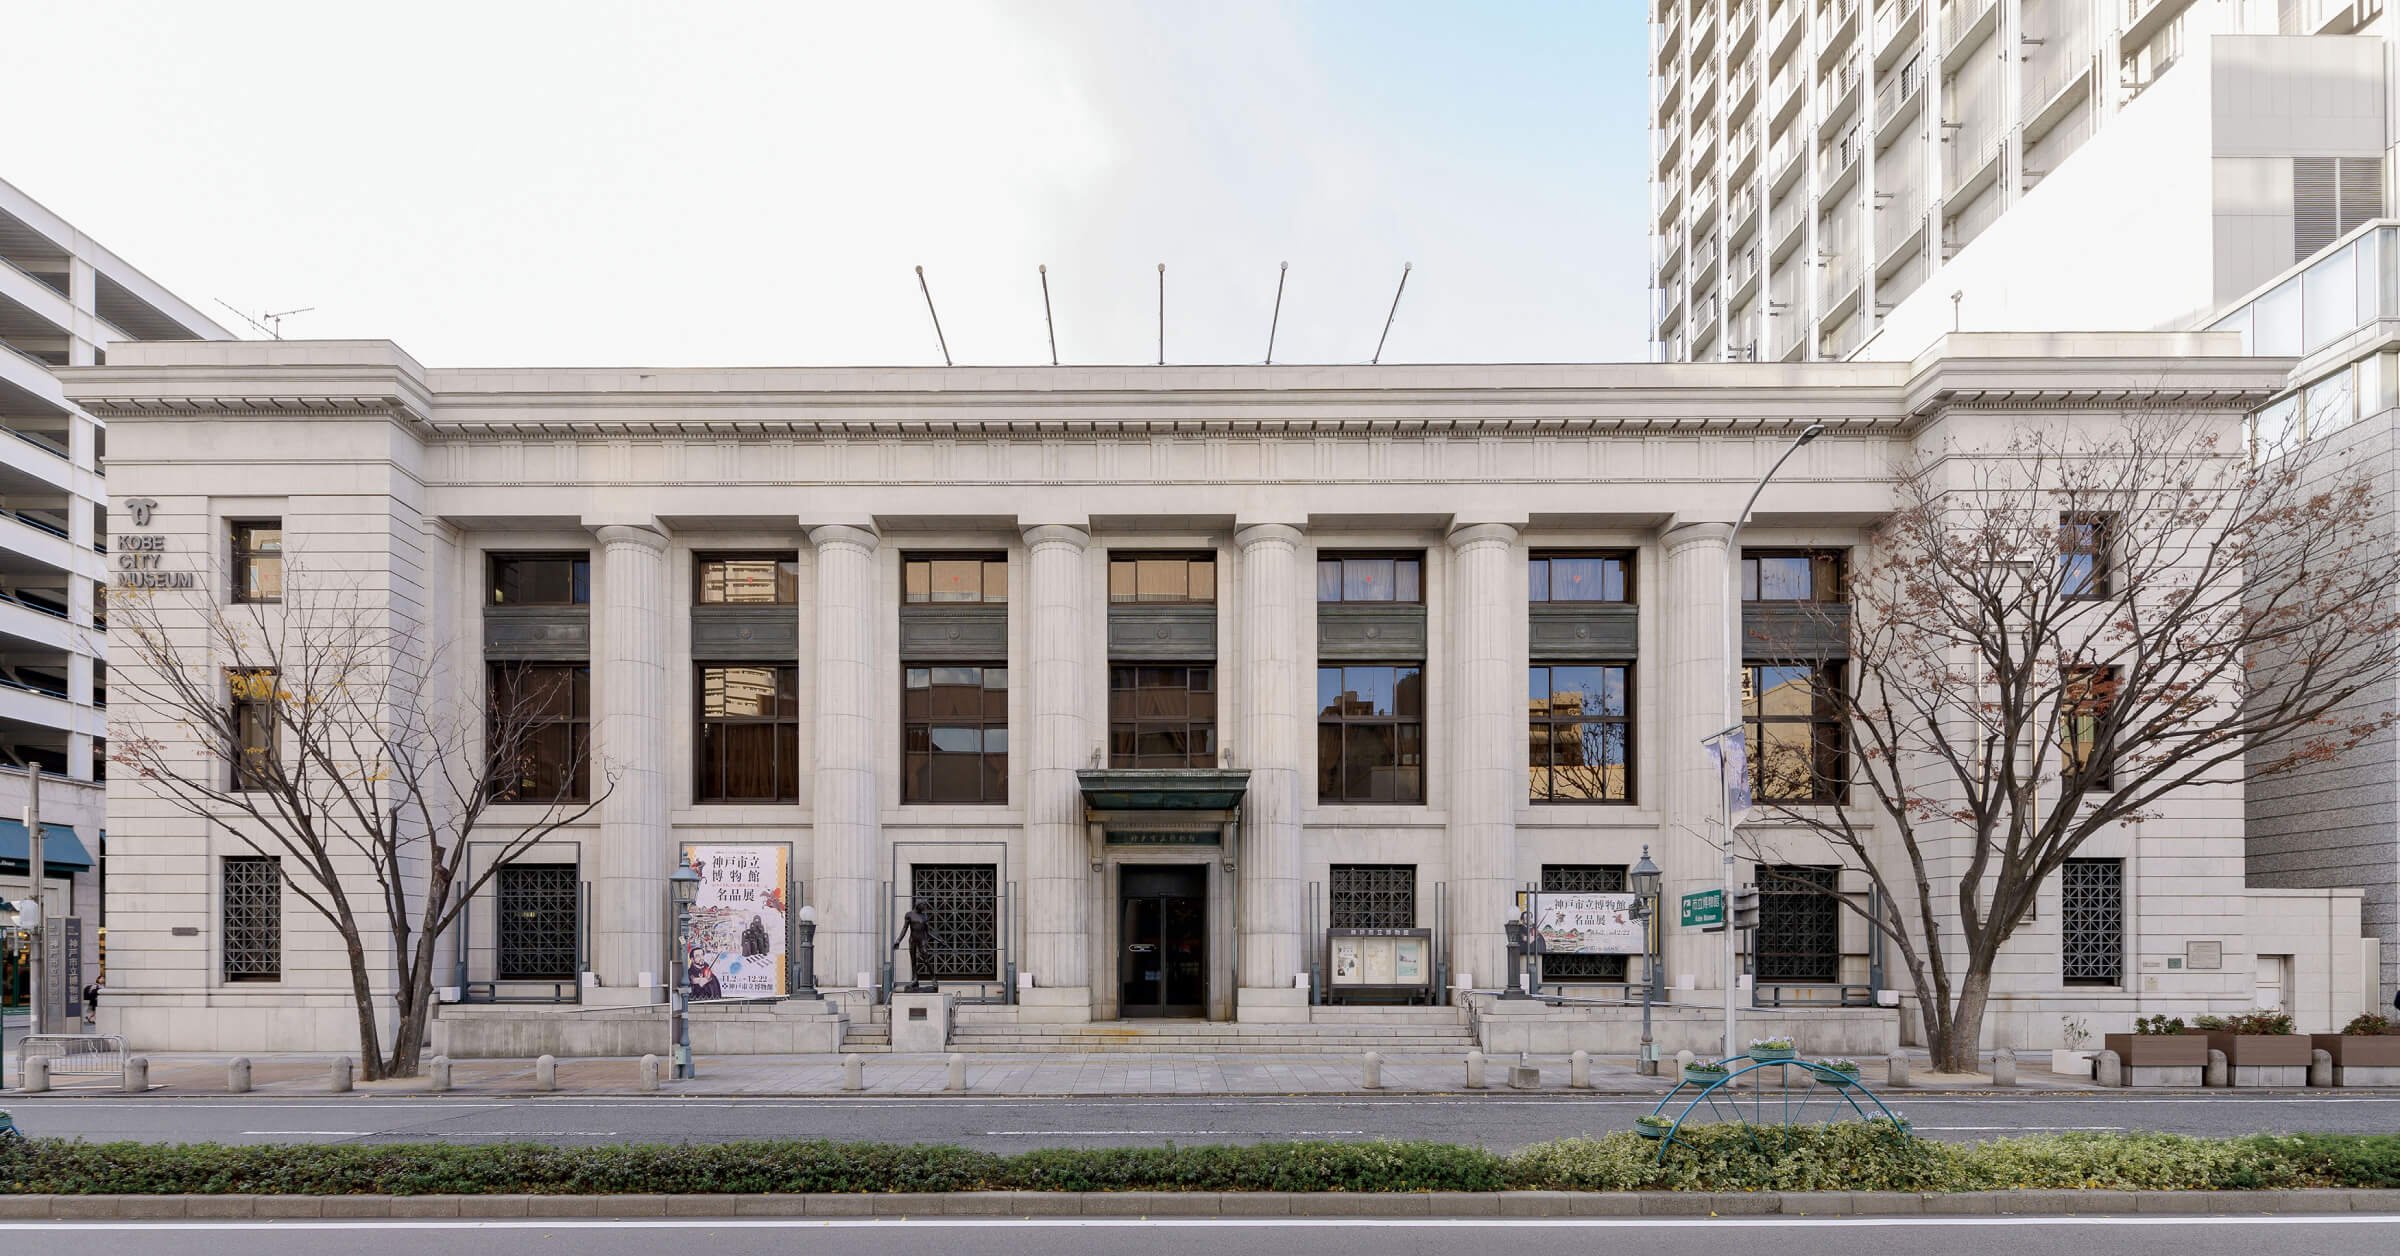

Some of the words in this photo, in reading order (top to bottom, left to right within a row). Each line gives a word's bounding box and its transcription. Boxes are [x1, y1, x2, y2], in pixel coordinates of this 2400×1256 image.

[118, 535, 165, 552] KOBE
[119, 554, 161, 569] CITY
[118, 572, 193, 588] MUSEUM
[712, 855, 760, 869] 神戸市立
[712, 870, 760, 882] 博物館
[717, 888, 755, 902] 名品展
[1555, 899, 1627, 910] 神戸市立博物館
[1575, 914, 1606, 926] 名品展
